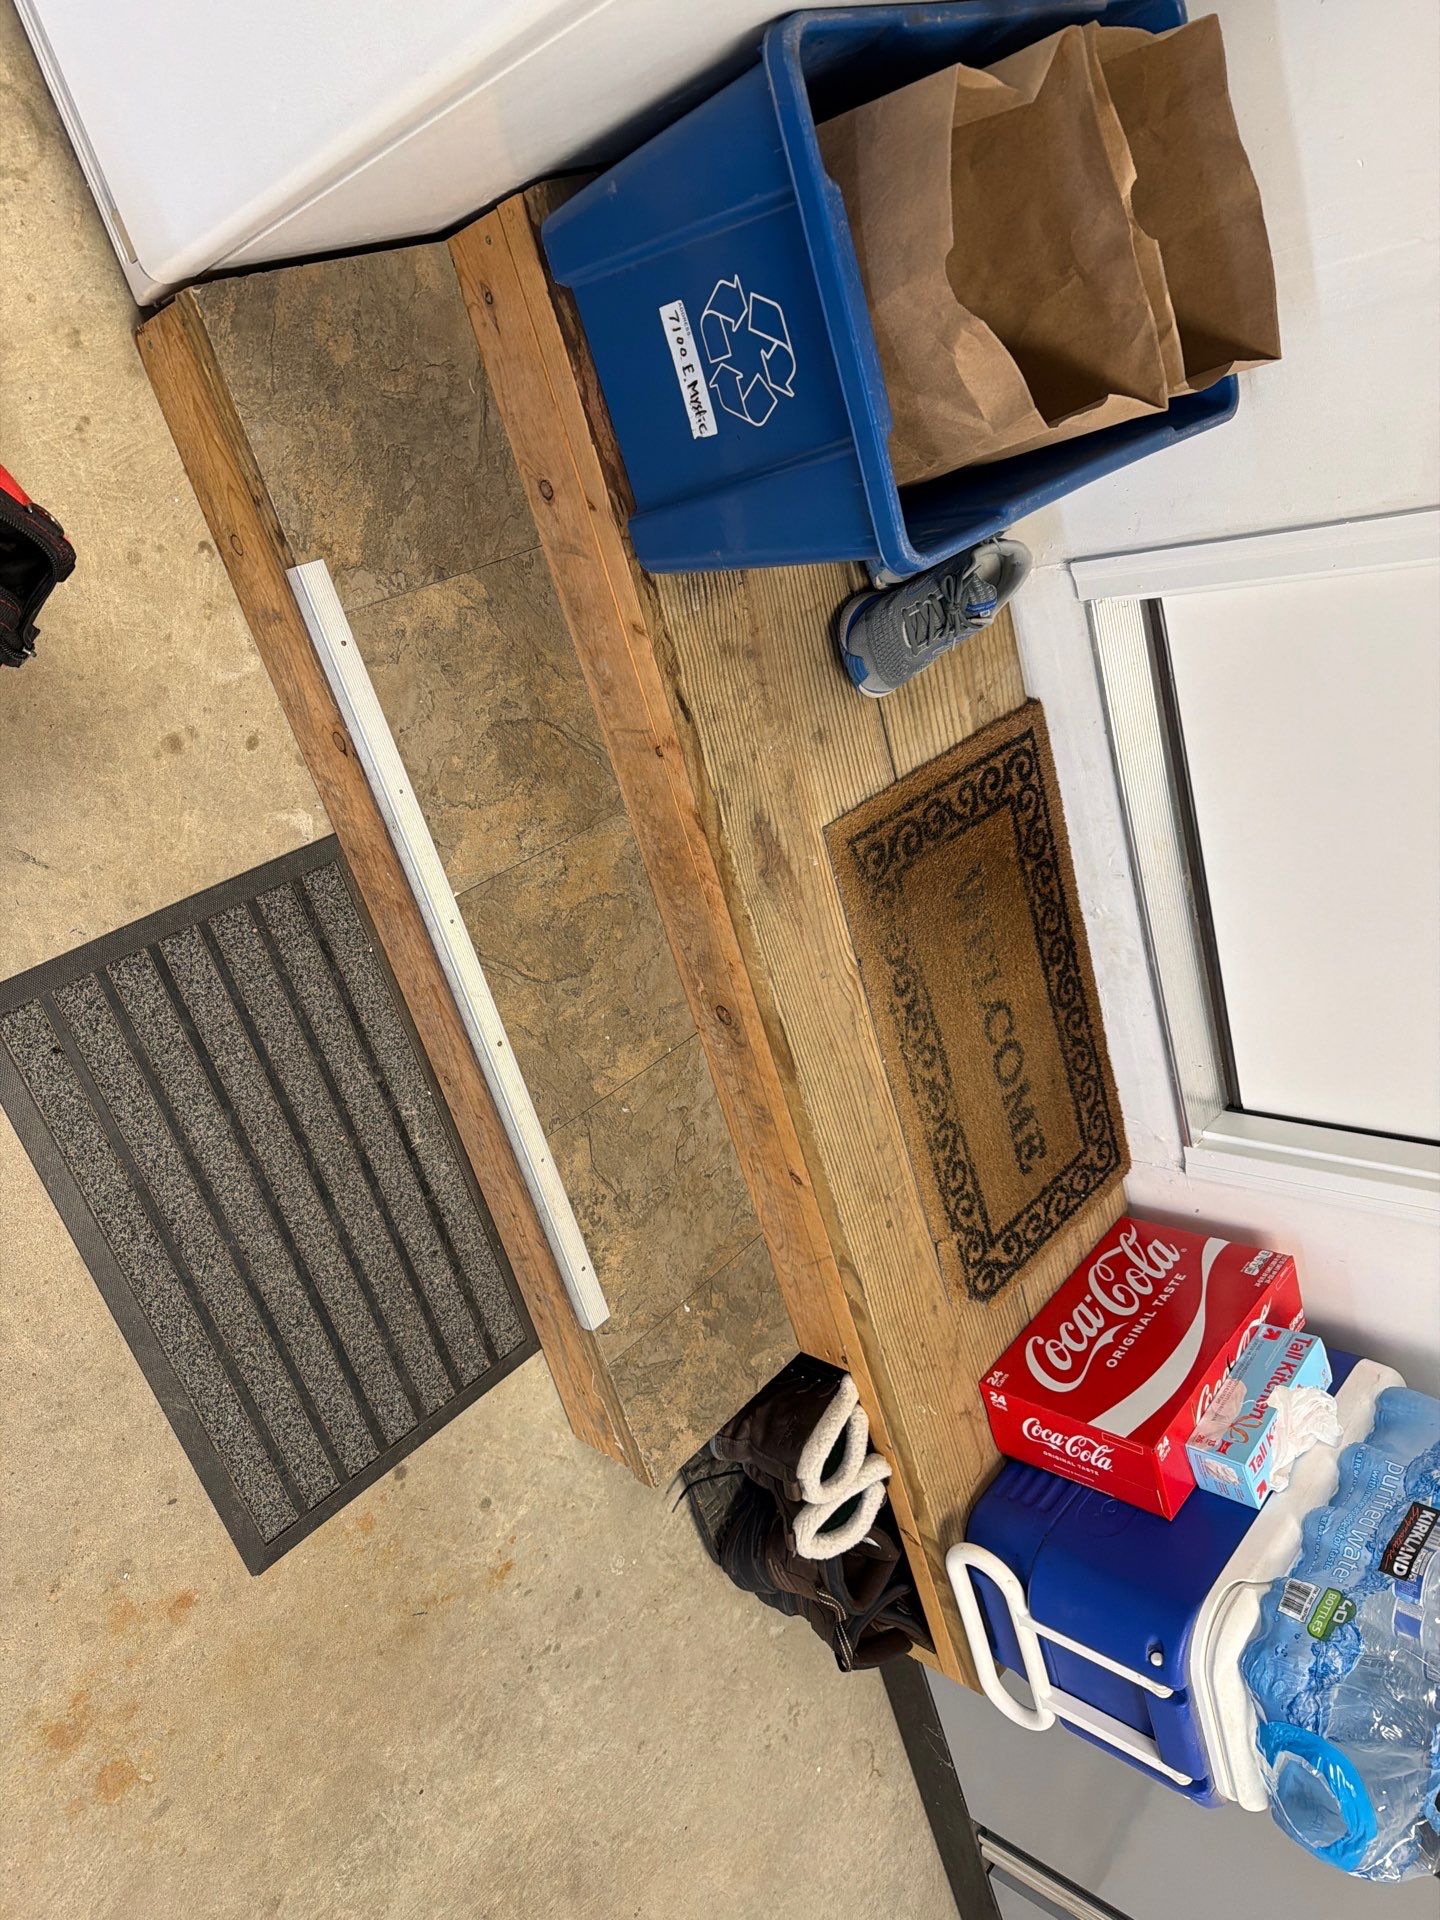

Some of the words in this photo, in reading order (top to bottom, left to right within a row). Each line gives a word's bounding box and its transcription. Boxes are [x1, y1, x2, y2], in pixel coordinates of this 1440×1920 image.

[669, 309, 687, 358] 7100
[678, 302, 691, 336] ADDRESS
[953, 862, 1048, 1175] WELCOME
[1025, 1224, 1181, 1393] Coca-Cola
[1106, 1308, 1158, 1369] ORIGINAL
[1153, 1272, 1187, 1316] TASTE
[1285, 1337, 1313, 1361] Tall
[986, 1370, 1004, 1386] 24
[996, 1373, 1010, 1387] Cans
[989, 1391, 1008, 1406] 24
[1022, 1417, 1113, 1471] Coca-Cola
[1157, 1435, 1169, 1452] 24
[1248, 1442, 1268, 1474] Tall
[1043, 1450, 1076, 1467] ORIGINAL
[1076, 1463, 1100, 1476] TASTE
[1365, 1469, 1379, 1489] with
[1358, 1460, 1405, 1530] purified
[1333, 1532, 1346, 1547] for
[1384, 1506, 1420, 1571] Signature
[1392, 1509, 1437, 1577] KIRKLAND
[1323, 1549, 1340, 1571] taste
[1332, 1529, 1369, 1583] water
[1312, 1593, 1338, 1634] BOTTLES
[1332, 1600, 1353, 1624] 40
